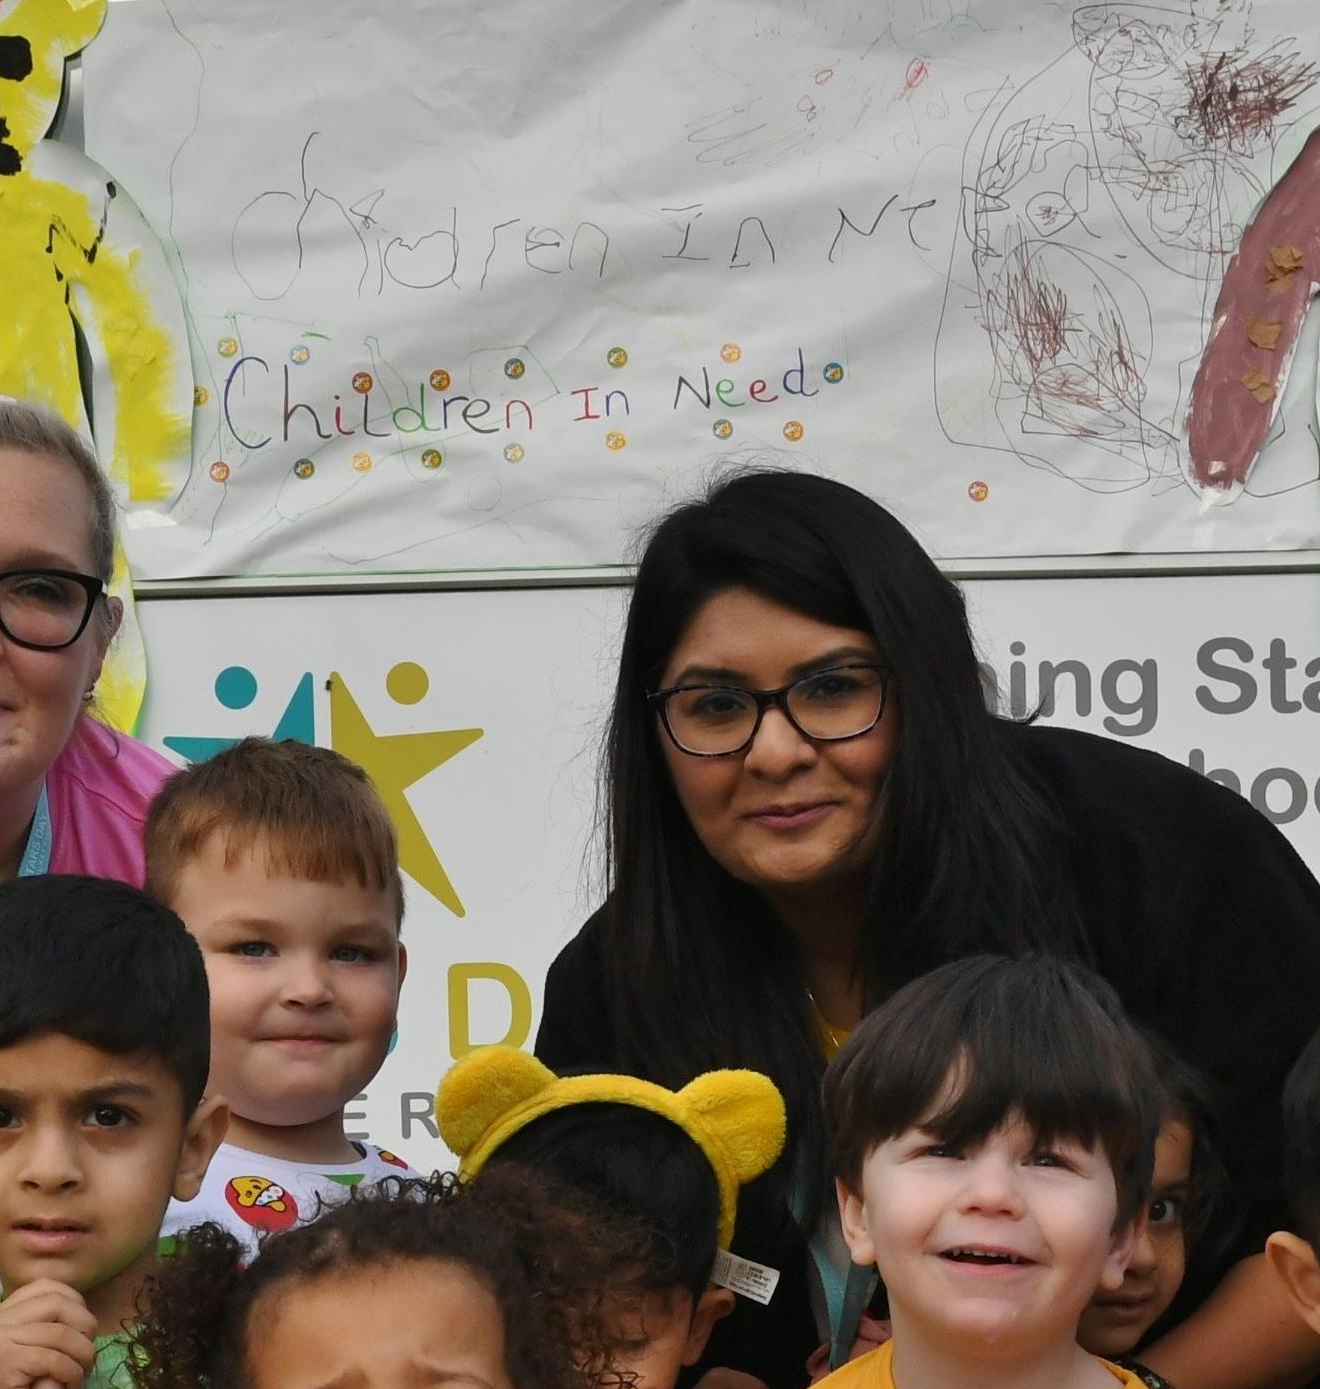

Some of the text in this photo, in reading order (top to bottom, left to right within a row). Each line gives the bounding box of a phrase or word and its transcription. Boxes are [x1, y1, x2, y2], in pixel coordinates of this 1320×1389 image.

[224, 346, 820, 448] Children In Need
